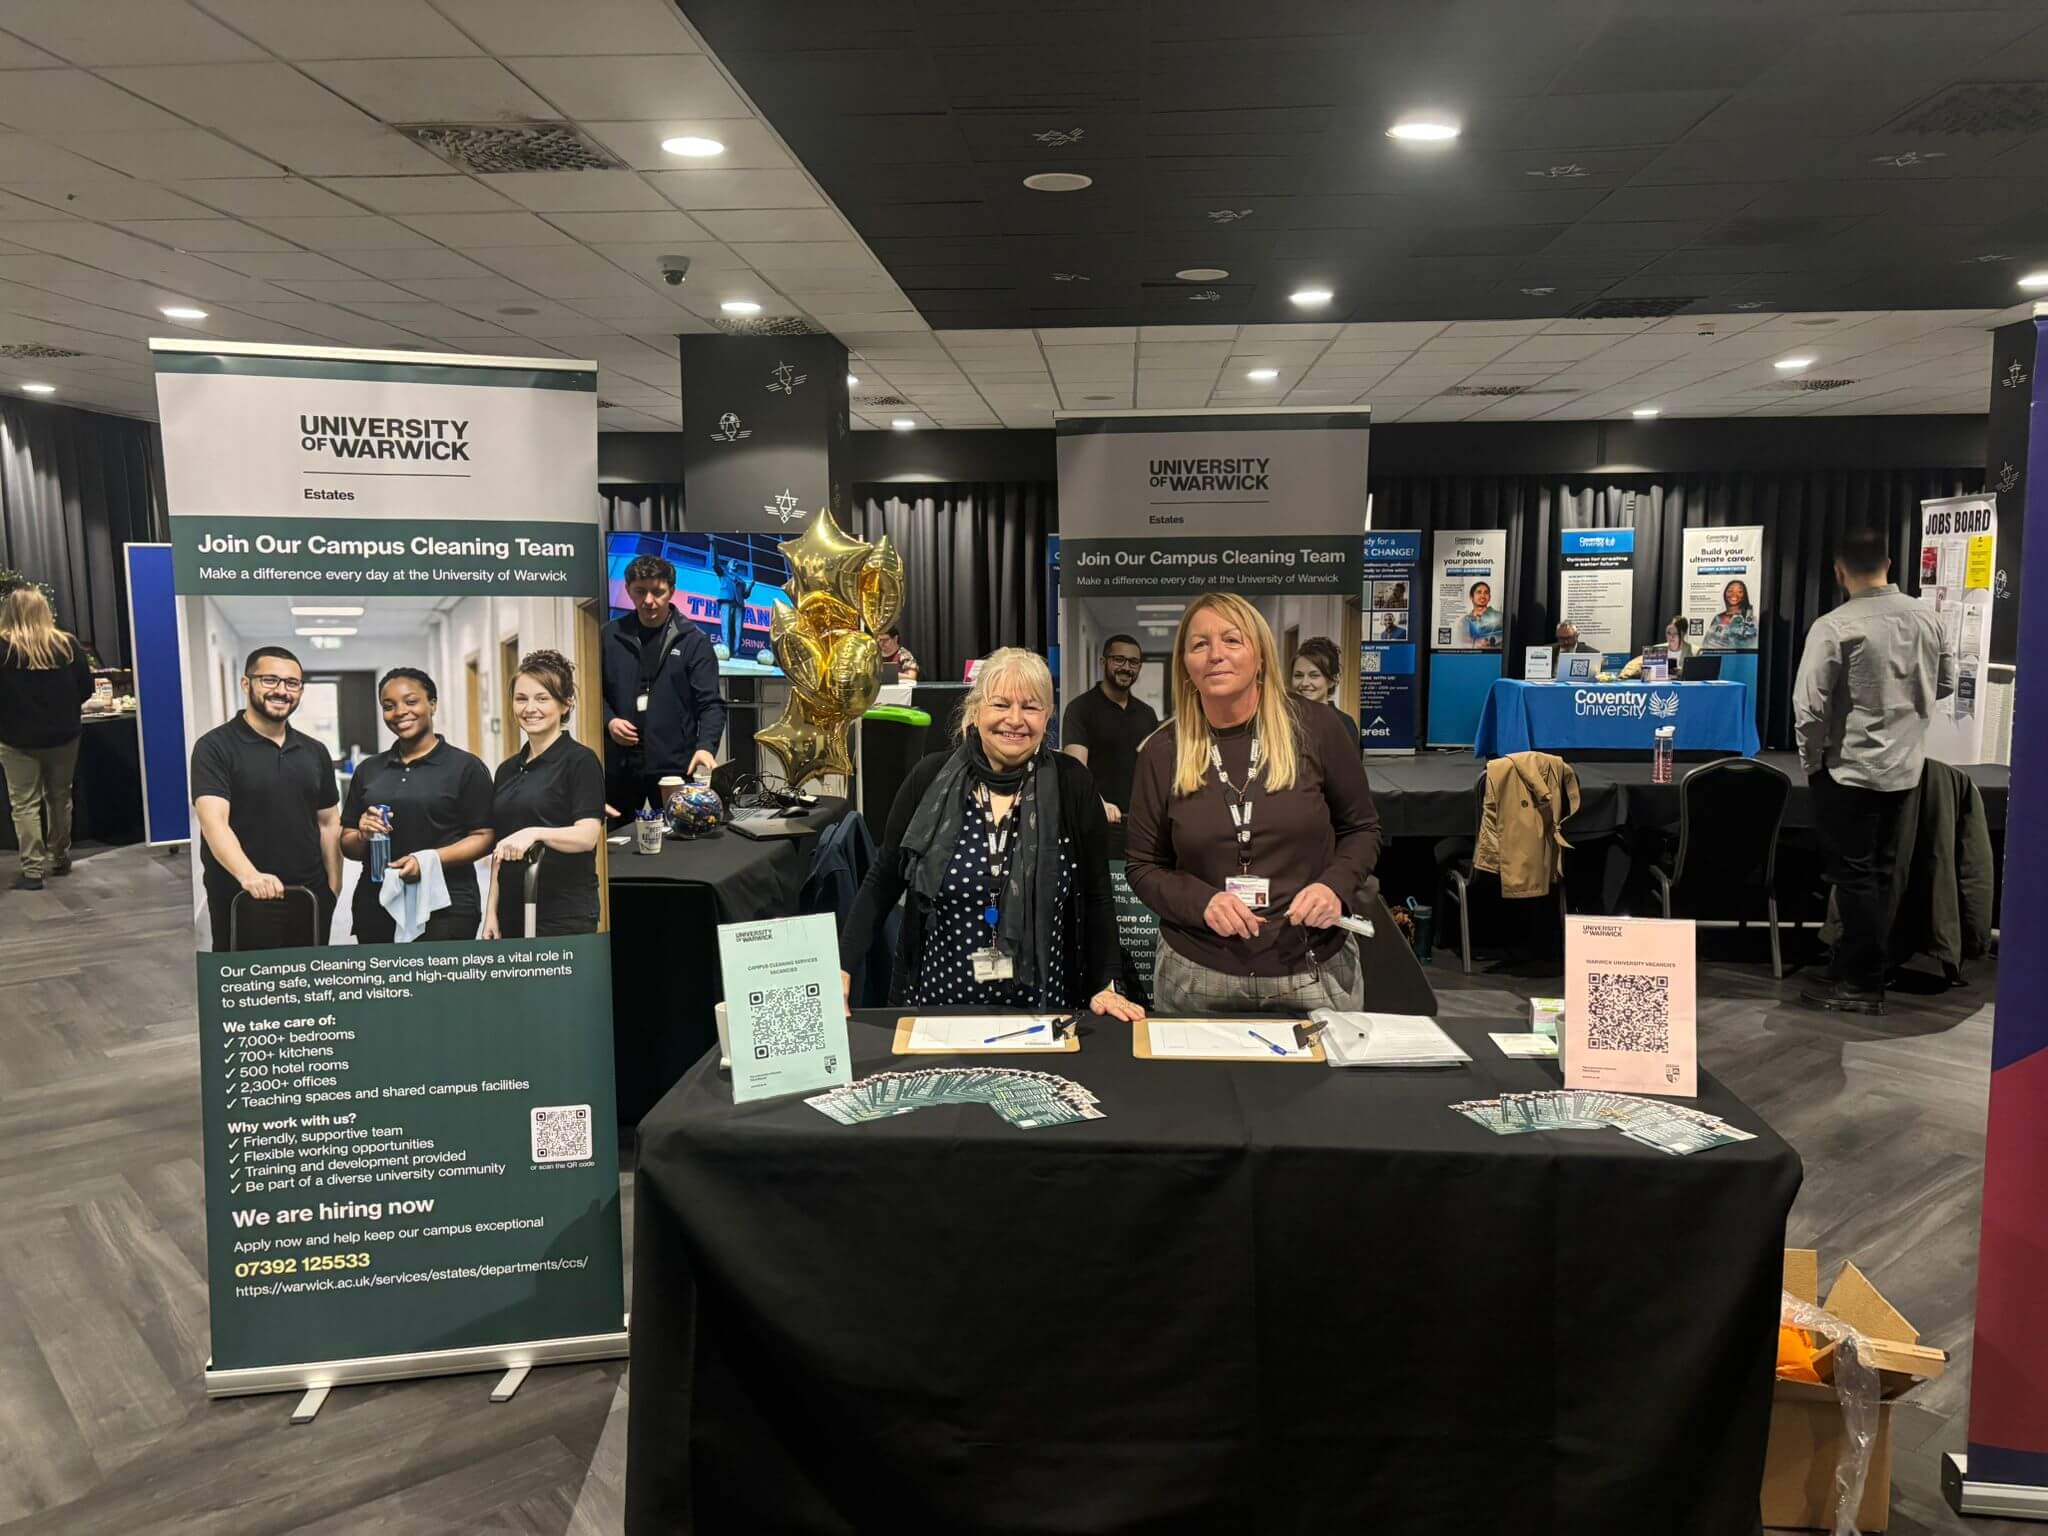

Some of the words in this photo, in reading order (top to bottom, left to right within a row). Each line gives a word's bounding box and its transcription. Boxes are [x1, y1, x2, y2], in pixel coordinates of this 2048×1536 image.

[300, 414, 469, 440] UNIVERSITY
[302, 438, 327, 452] OF
[330, 437, 471, 461] WARWICK
[1149, 457, 1270, 476] UNIVERSITY
[1150, 476, 1168, 488] OF
[1169, 474, 1269, 492] WARWICK
[303, 488, 355, 501] Estates
[1148, 515, 1185, 525] Estates
[1925, 512, 1952, 535] JOBS
[1954, 509, 1991, 532] BOARD
[197, 533, 250, 553] Join
[255, 534, 302, 554] Our
[307, 535, 405, 559] Campus
[410, 536, 510, 560] Cleaning
[514, 538, 575, 557] Team
[1377, 537, 1389, 545] for
[1076, 551, 1111, 567] Join
[1114, 551, 1146, 566] Our
[1149, 550, 1218, 568] Campus
[1222, 549, 1296, 567] Cleaning
[1299, 548, 1346, 564] Team
[1724, 548, 1744, 556] your
[1443, 558, 1461, 566] your
[1463, 558, 1495, 566] passion.
[199, 566, 237, 580] Make
[240, 569, 250, 580] a
[252, 567, 322, 580] difference
[325, 570, 363, 583] every
[365, 568, 390, 583] day
[392, 569, 406, 581] at
[408, 568, 430, 581] the
[432, 568, 495, 583] University
[497, 569, 511, 581] of
[513, 569, 568, 582] Warwick
[1076, 575, 1102, 586] Make
[1103, 577, 1110, 585] a
[1111, 575, 1159, 585] difference
[1160, 576, 1187, 586] every
[1188, 575, 1206, 586] day
[1207, 575, 1217, 584] at
[1219, 575, 1235, 584] the
[1236, 574, 1284, 585] University
[1284, 573, 1296, 584] of
[1297, 573, 1339, 583] Warwick
[1575, 689, 1647, 708] Coventry
[1575, 703, 1647, 720] University
[1116, 914, 1138, 923] care
[1139, 914, 1152, 923] of:
[1119, 926, 1160, 935] bedroom
[220, 966, 247, 978] Our
[249, 963, 307, 976] Campus
[310, 958, 367, 972] Cleaning
[369, 956, 425, 969] Services
[427, 955, 459, 967] team
[462, 953, 495, 967] plays
[497, 954, 506, 964] a
[508, 951, 533, 963] vital
[536, 950, 560, 962] role
[562, 949, 574, 961] in
[220, 979, 276, 993] creating
[279, 976, 311, 989] safe,
[313, 972, 386, 987] welcoming,
[388, 970, 413, 983] and
[415, 967, 488, 984] high-quality
[490, 964, 573, 979] environments
[221, 997, 236, 1009] to
[238, 992, 301, 1008] students,
[303, 989, 336, 1003] staff,
[338, 988, 363, 1001] and
[365, 987, 414, 1000] visitors.
[222, 1021, 246, 1033] We
[248, 1019, 281, 1032] take
[283, 1017, 315, 1028] care
[318, 1014, 336, 1026] of:
[237, 1033, 286, 1049] 7,000+
[289, 1030, 356, 1043] bedrooms
[238, 1049, 275, 1063] 700+
[279, 1046, 334, 1059] kitchens
[239, 1064, 269, 1078] 500
[272, 1061, 305, 1075] hotel
[308, 1060, 350, 1072] rooms
[240, 1078, 290, 1094] 2,300+
[293, 1075, 337, 1088] offices
[241, 1092, 302, 1108] Teaching
[305, 1090, 352, 1104] spaces
[354, 1086, 379, 1099] and
[382, 1084, 426, 1098] shared
[428, 1083, 479, 1096] campus
[481, 1078, 530, 1092] facilities
[227, 1121, 260, 1134] Why
[262, 1116, 298, 1131] work
[300, 1114, 330, 1127] with
[333, 1112, 357, 1125] us?
[243, 1132, 298, 1148] Friendly,
[301, 1127, 368, 1143] supportive
[371, 1126, 403, 1138] team
[243, 1147, 295, 1163] Flexible
[297, 1143, 349, 1158] working
[351, 1138, 435, 1156] opportunities
[244, 1162, 297, 1177] Training
[300, 1159, 325, 1173] and
[327, 1154, 409, 1170] development
[412, 1149, 466, 1167] provided
[578, 1160, 595, 1168] code
[245, 1181, 265, 1193] Be
[268, 1177, 295, 1193] part
[298, 1175, 312, 1188] of
[315, 1177, 324, 1186] a
[326, 1173, 373, 1186] diverse
[375, 1167, 435, 1182] university
[438, 1162, 506, 1178] community
[231, 1208, 271, 1228] We
[276, 1208, 314, 1224] are
[319, 1200, 382, 1220] hiring
[388, 1199, 435, 1215] now
[233, 1238, 272, 1254] Apply
[275, 1237, 303, 1248] now
[305, 1233, 330, 1246] and
[333, 1231, 361, 1245] help
[364, 1230, 396, 1242] keep
[398, 1228, 420, 1239] our
[422, 1224, 473, 1237] campus
[475, 1216, 544, 1232] exceptional
[234, 1258, 297, 1278] 07392
[301, 1252, 371, 1272] 125533
[235, 1255, 589, 1298] https://warwick.ac.uk/services/estates/departments/ccs/
